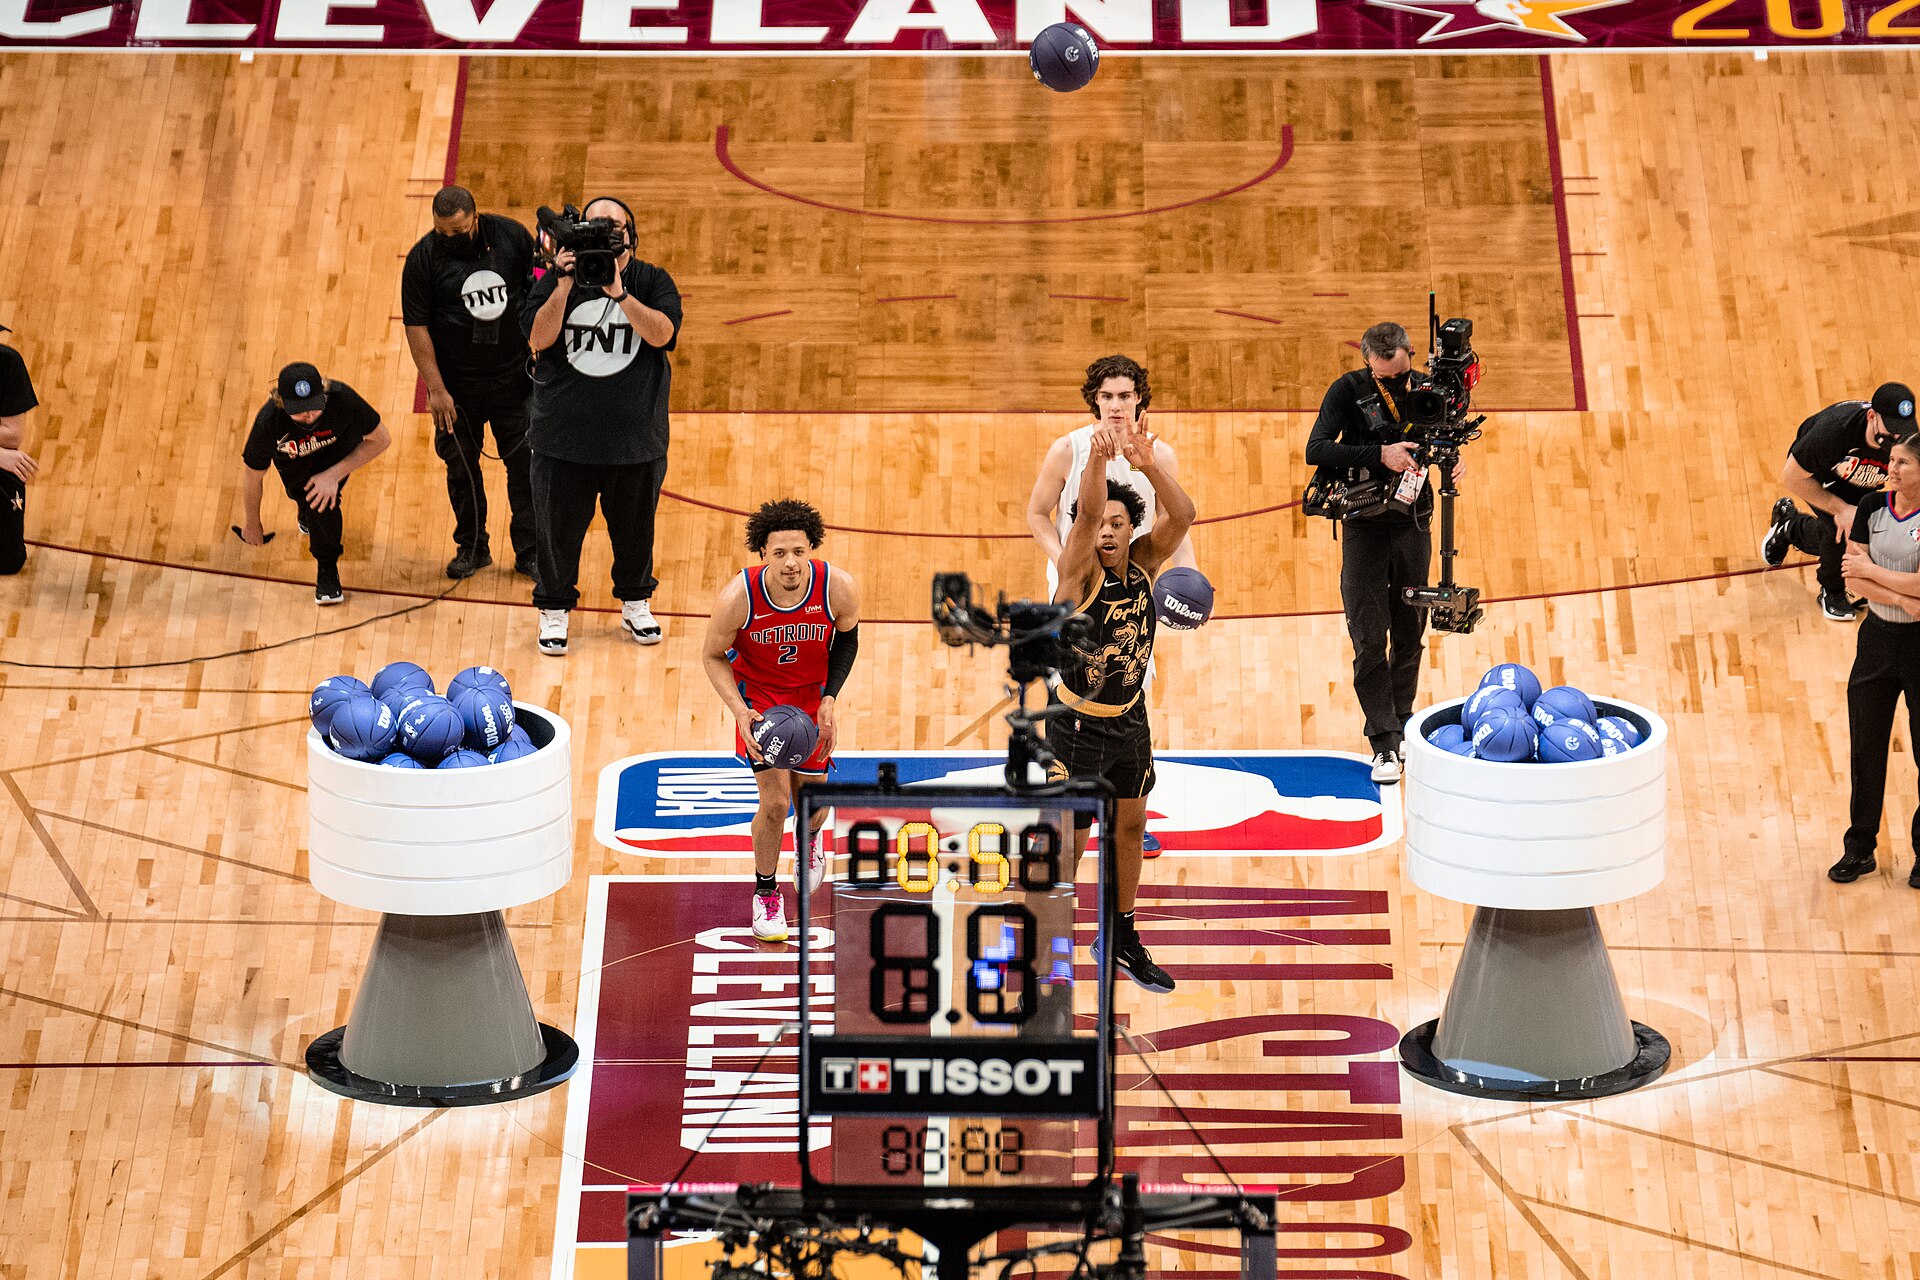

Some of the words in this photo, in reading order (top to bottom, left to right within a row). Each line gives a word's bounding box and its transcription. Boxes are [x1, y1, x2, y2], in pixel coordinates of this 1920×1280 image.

[462, 284, 507, 308] TNT
[566, 322, 634, 355] TNT
[805, 605, 822, 613] UWM
[1164, 594, 1204, 621] Wilson
[750, 623, 828, 645] DETROIT
[1140, 616, 1148, 636] 4
[778, 644, 798, 665] 2
[482, 703, 499, 747] Wilson
[767, 736, 780, 755] TACO
[772, 740, 785, 757] BELL
[655, 767, 763, 817] NBA
[680, 927, 836, 1154] CLEVELAND
[893, 1058, 1085, 1096] TISSOT
